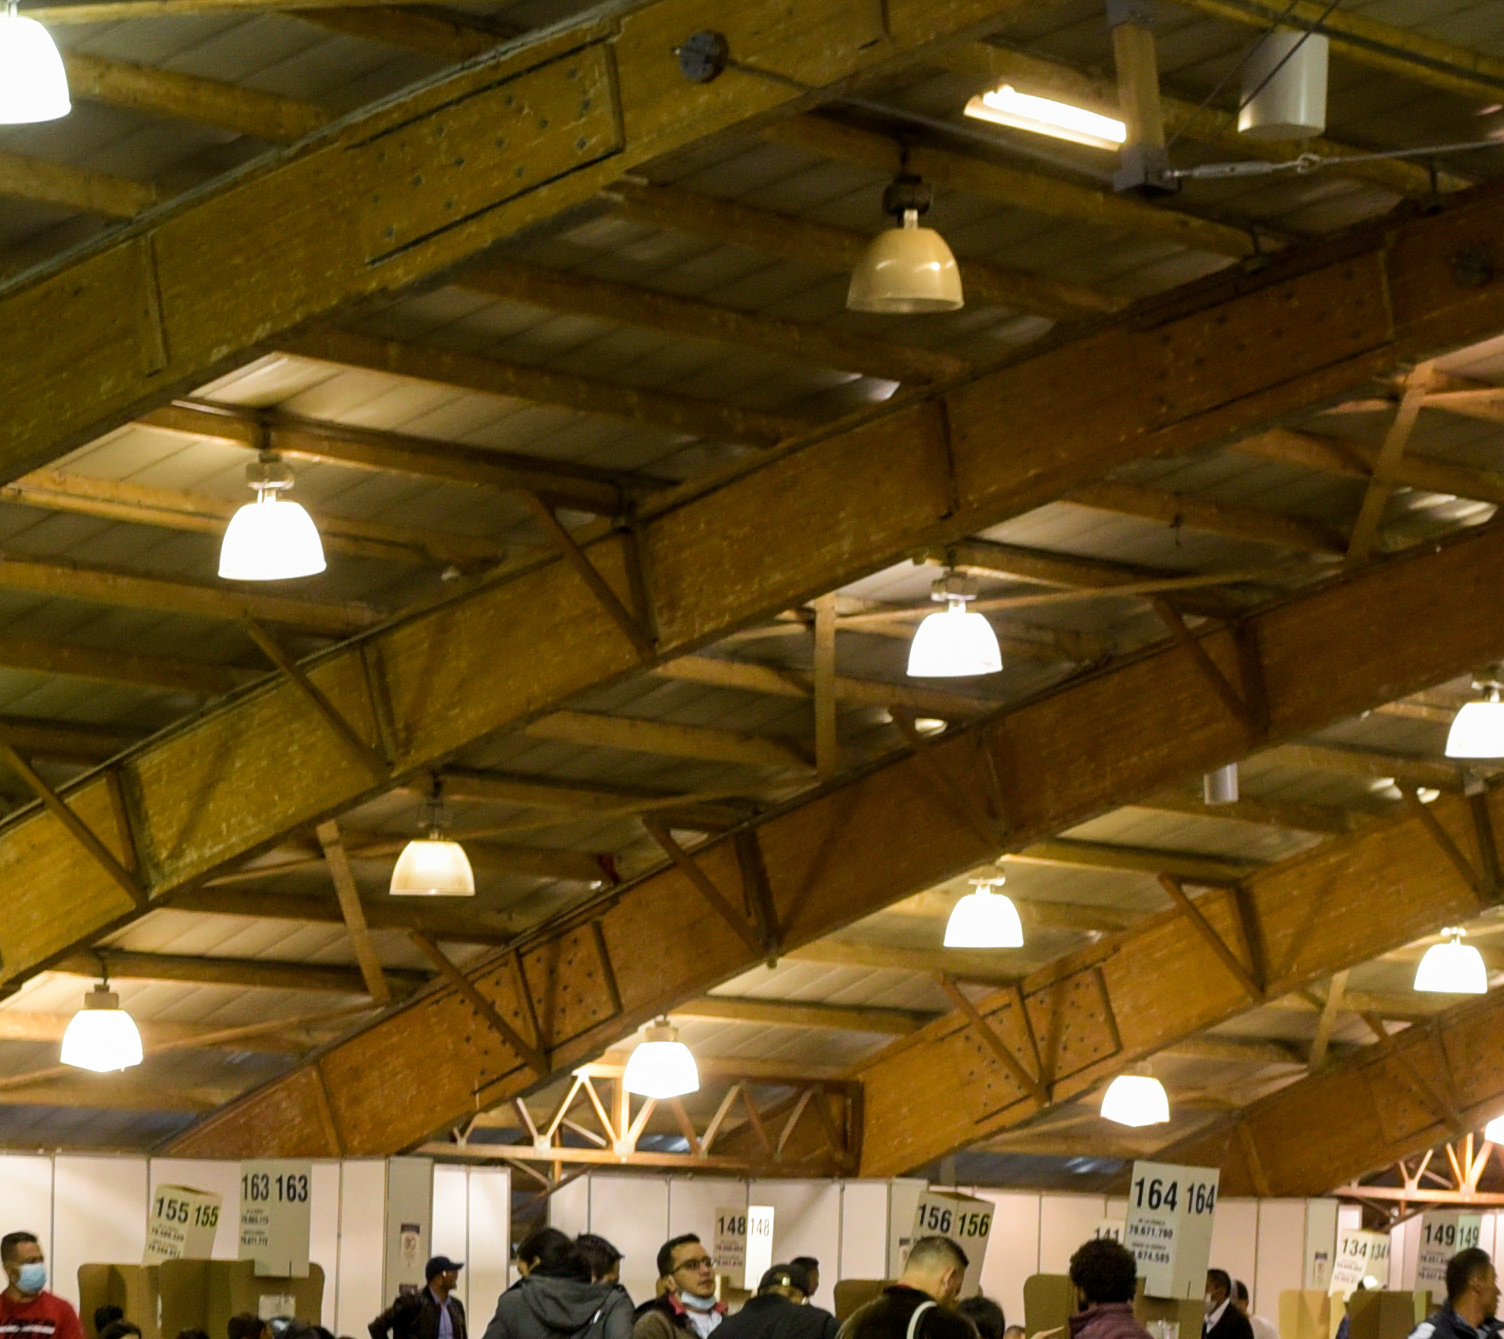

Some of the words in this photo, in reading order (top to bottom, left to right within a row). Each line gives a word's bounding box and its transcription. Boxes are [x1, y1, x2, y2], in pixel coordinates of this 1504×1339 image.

[241, 1173, 270, 1201] 163
[274, 1174, 309, 1204] 163
[1134, 1177, 1179, 1213] 164
[1186, 1182, 1216, 1215] 164
[156, 1197, 191, 1225] 155
[195, 1204, 220, 1228] 155
[918, 1203, 952, 1234] 156
[717, 1215, 747, 1236] 148
[750, 1218, 770, 1237] 148
[958, 1212, 991, 1238] 156
[1424, 1223, 1456, 1247] 149
[1459, 1226, 1480, 1248] 149
[1342, 1238, 1368, 1258] 134
